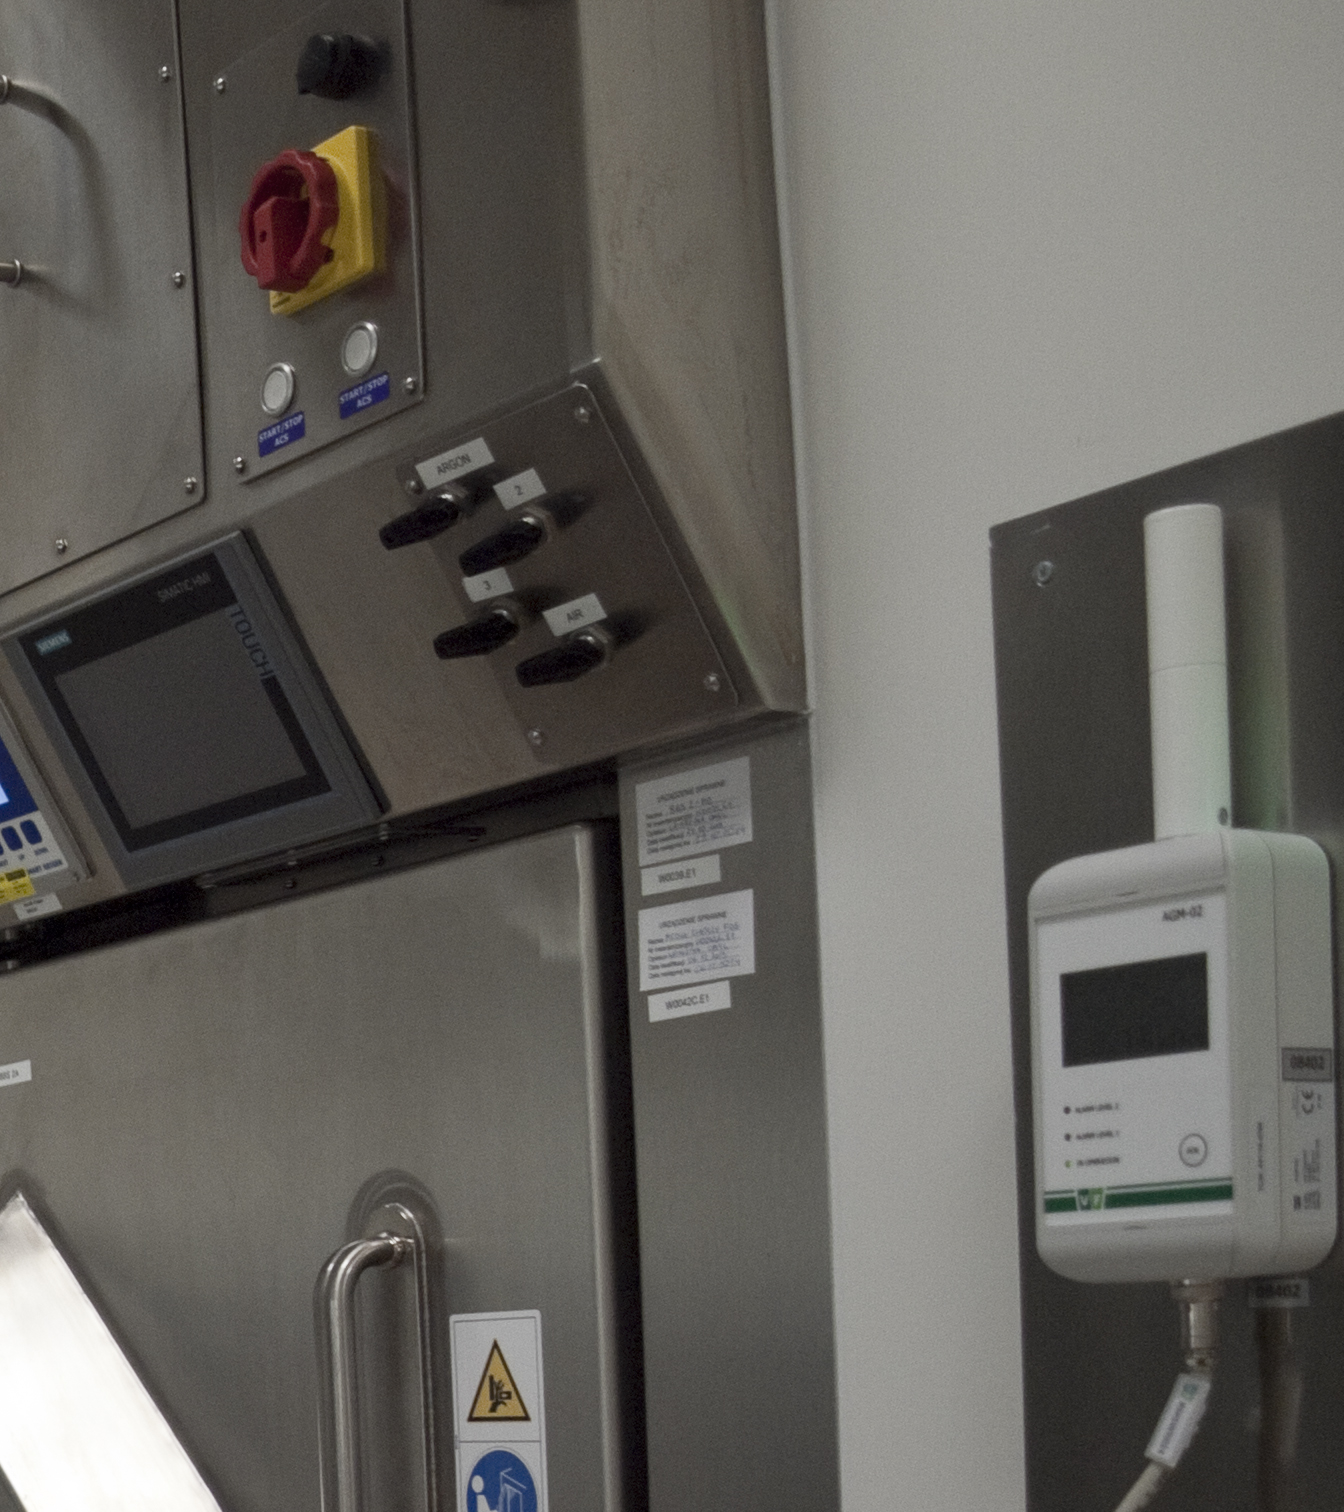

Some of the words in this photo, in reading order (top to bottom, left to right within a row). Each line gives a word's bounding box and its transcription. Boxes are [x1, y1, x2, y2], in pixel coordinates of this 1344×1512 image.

[338, 374, 389, 405] START/STOP
[356, 395, 373, 409] ACS
[258, 413, 304, 444] START/STOP
[274, 434, 289, 447] ACS
[436, 453, 472, 476] ARGON
[514, 485, 524, 497] 2
[483, 580, 493, 591] 3
[566, 608, 586, 624] AIR
[36, 629, 72, 656] SIEMENS
[229, 604, 275, 678] TOUCH
[1161, 903, 1204, 922] AGM-02
